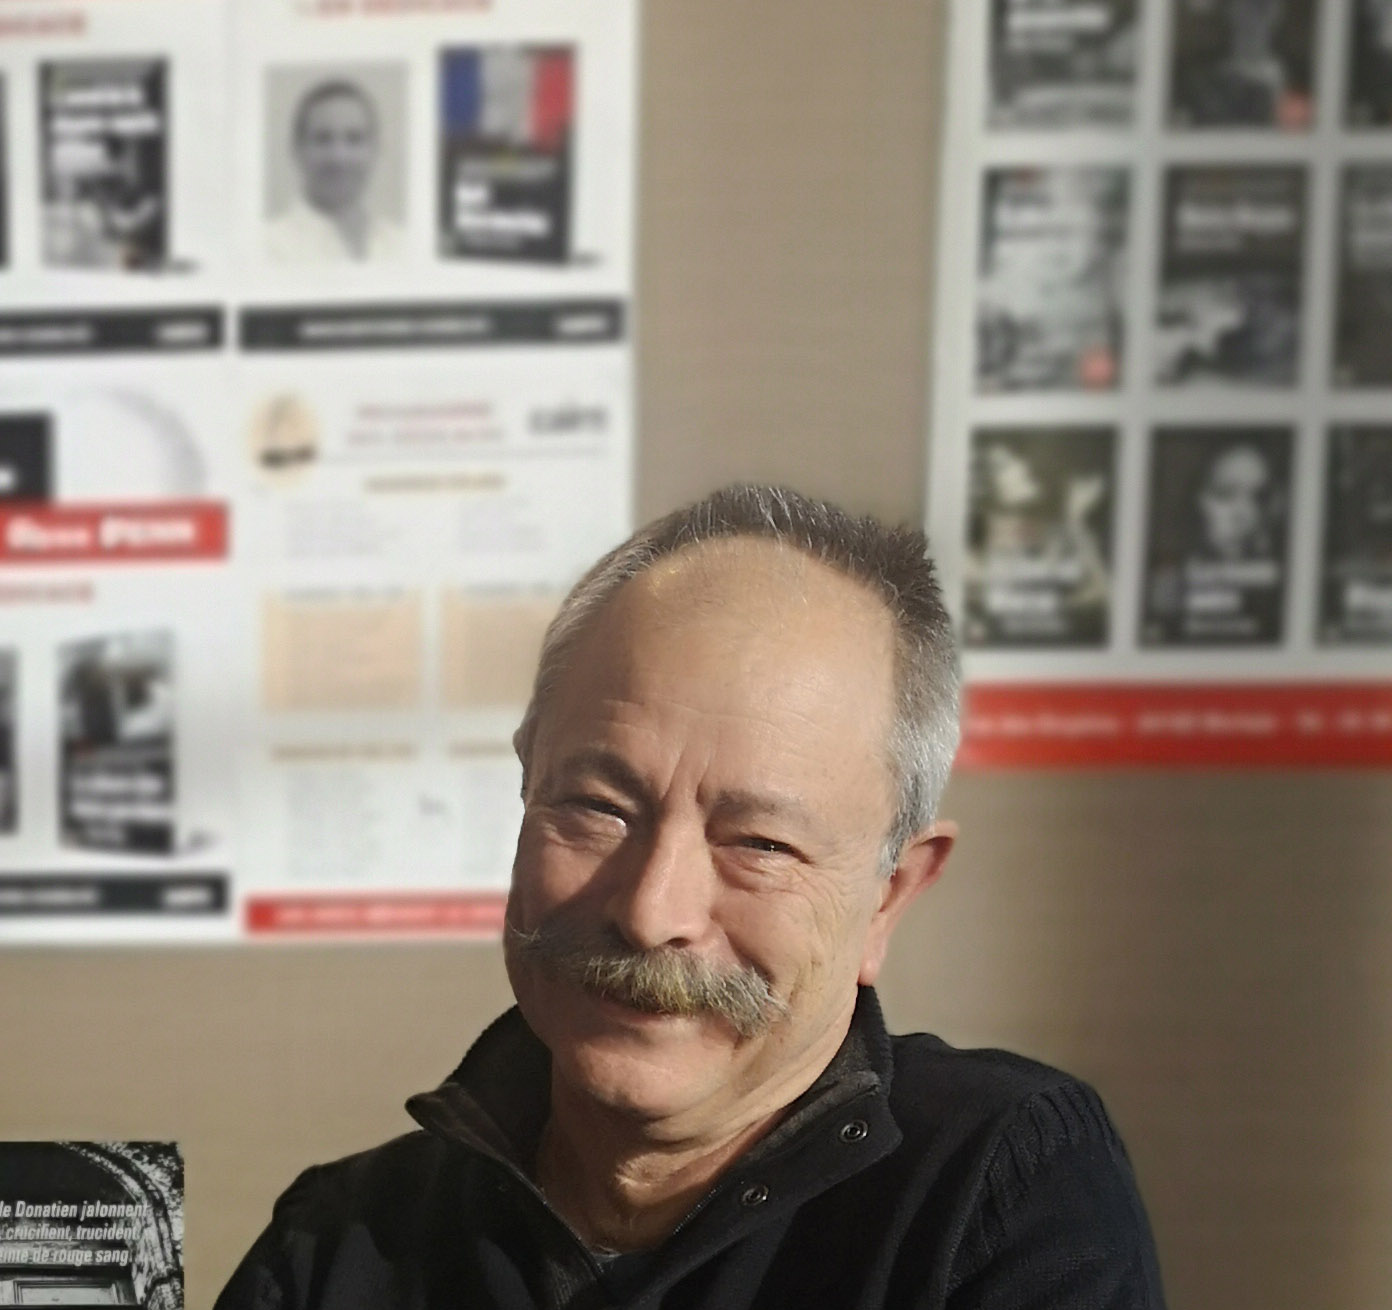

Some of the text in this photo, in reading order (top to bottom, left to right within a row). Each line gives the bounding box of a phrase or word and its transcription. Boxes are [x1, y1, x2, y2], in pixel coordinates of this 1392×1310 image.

[15, 1200, 78, 1218] Donatien
[80, 1200, 149, 1221] jalonnent
[53, 1248, 93, 1267] rouge
